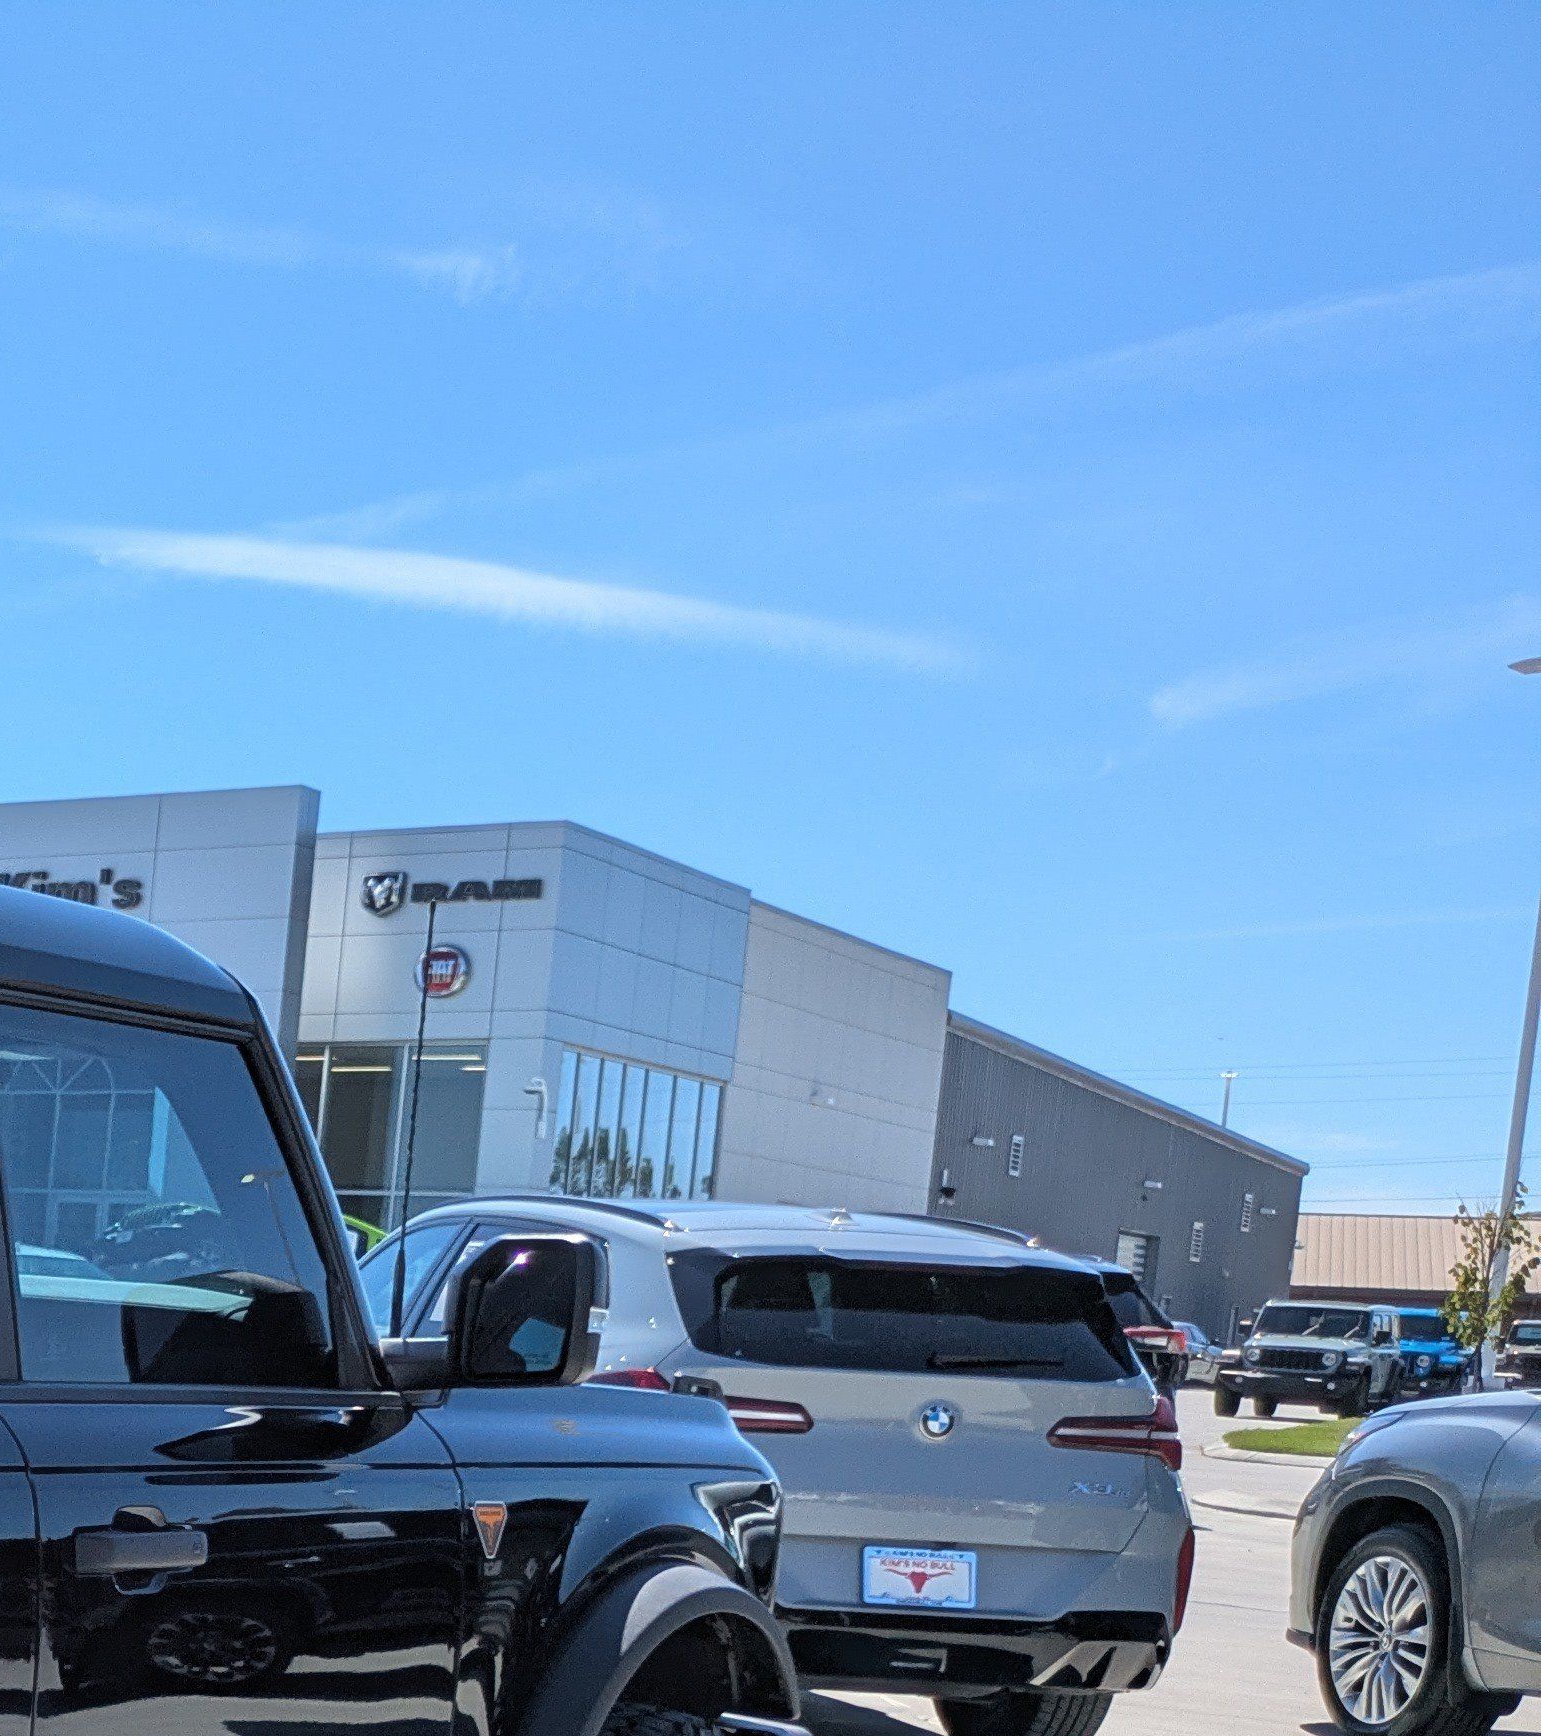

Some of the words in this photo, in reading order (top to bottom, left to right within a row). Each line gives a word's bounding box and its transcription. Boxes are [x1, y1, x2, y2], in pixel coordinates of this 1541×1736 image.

[410, 880, 543, 902] RAM
[879, 1557, 911, 1568] KIM'S
[912, 1559, 928, 1569] NO
[930, 1560, 956, 1571] BULL
